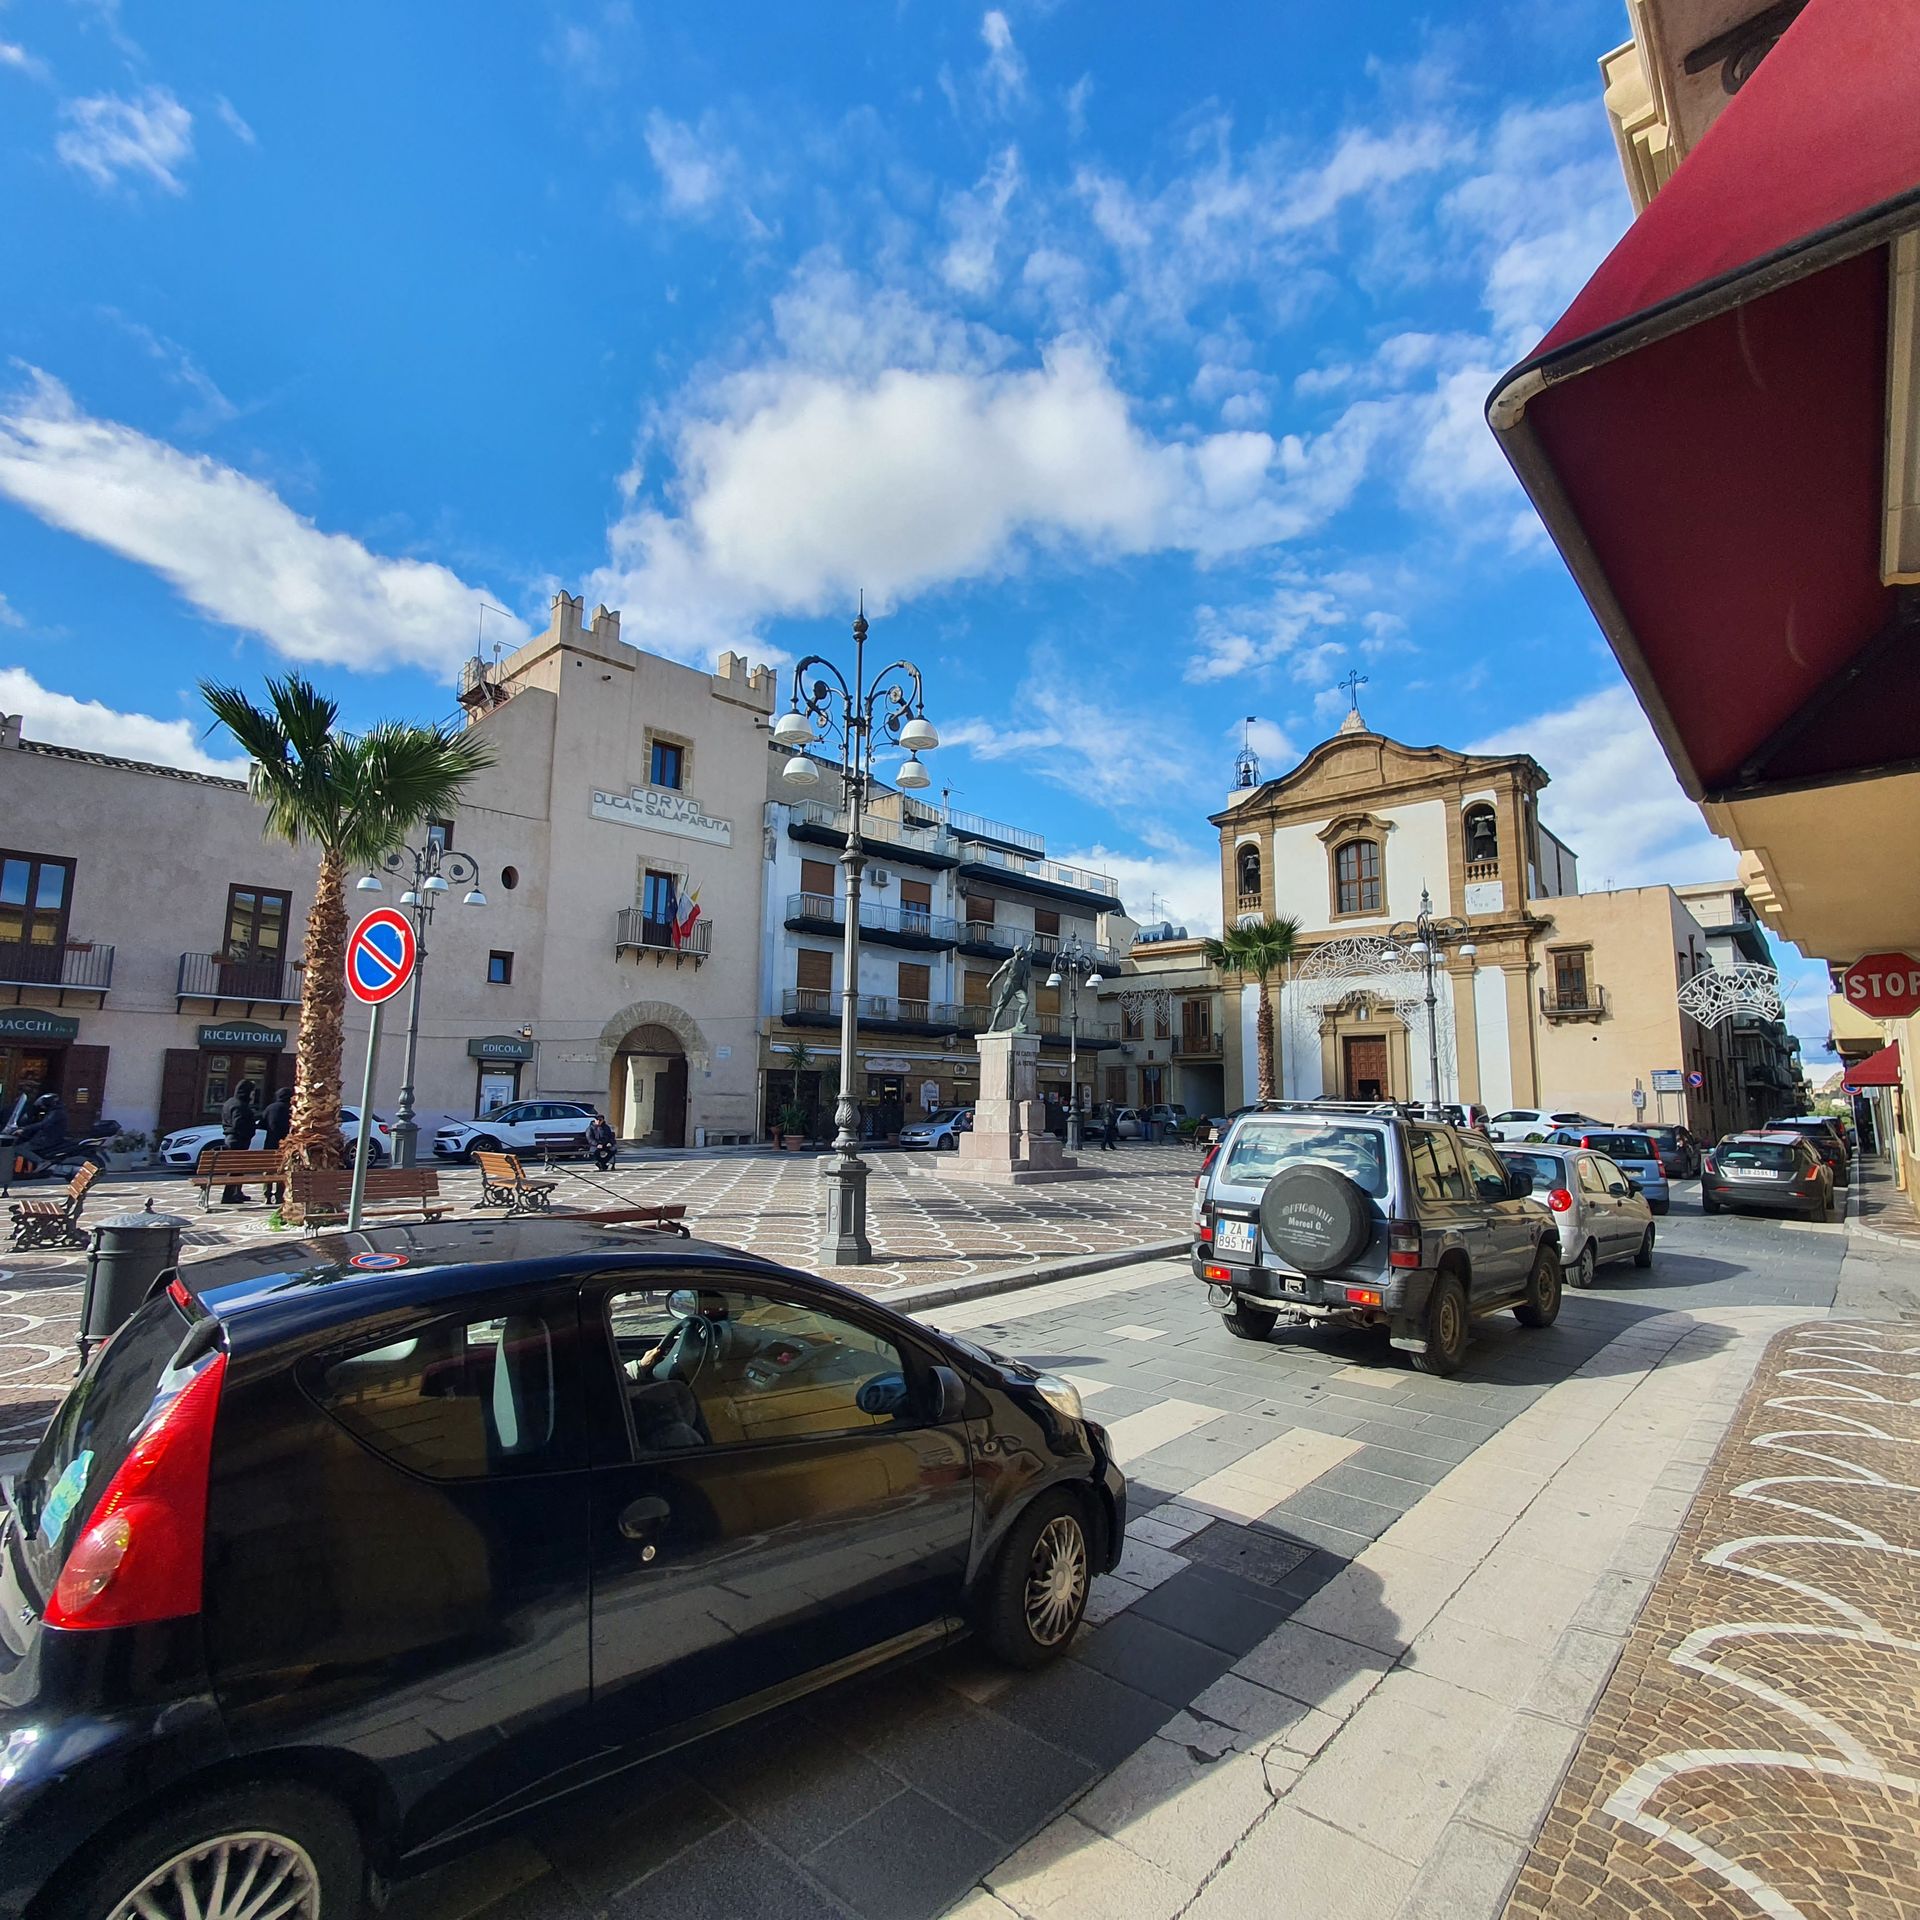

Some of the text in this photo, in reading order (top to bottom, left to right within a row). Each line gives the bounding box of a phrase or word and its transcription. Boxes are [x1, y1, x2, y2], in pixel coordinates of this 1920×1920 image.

[631, 788, 699, 815] CORVO
[593, 792, 632, 811] DUCA
[645, 804, 730, 833] SALAPARUTA
[1849, 972, 1920, 999] STOP
[203, 1029, 283, 1043] RICEVITORIA
[482, 1043, 523, 1054] EDICOLA
[1230, 1222, 1242, 1236] ZA
[1218, 1235, 1237, 1249] 895
